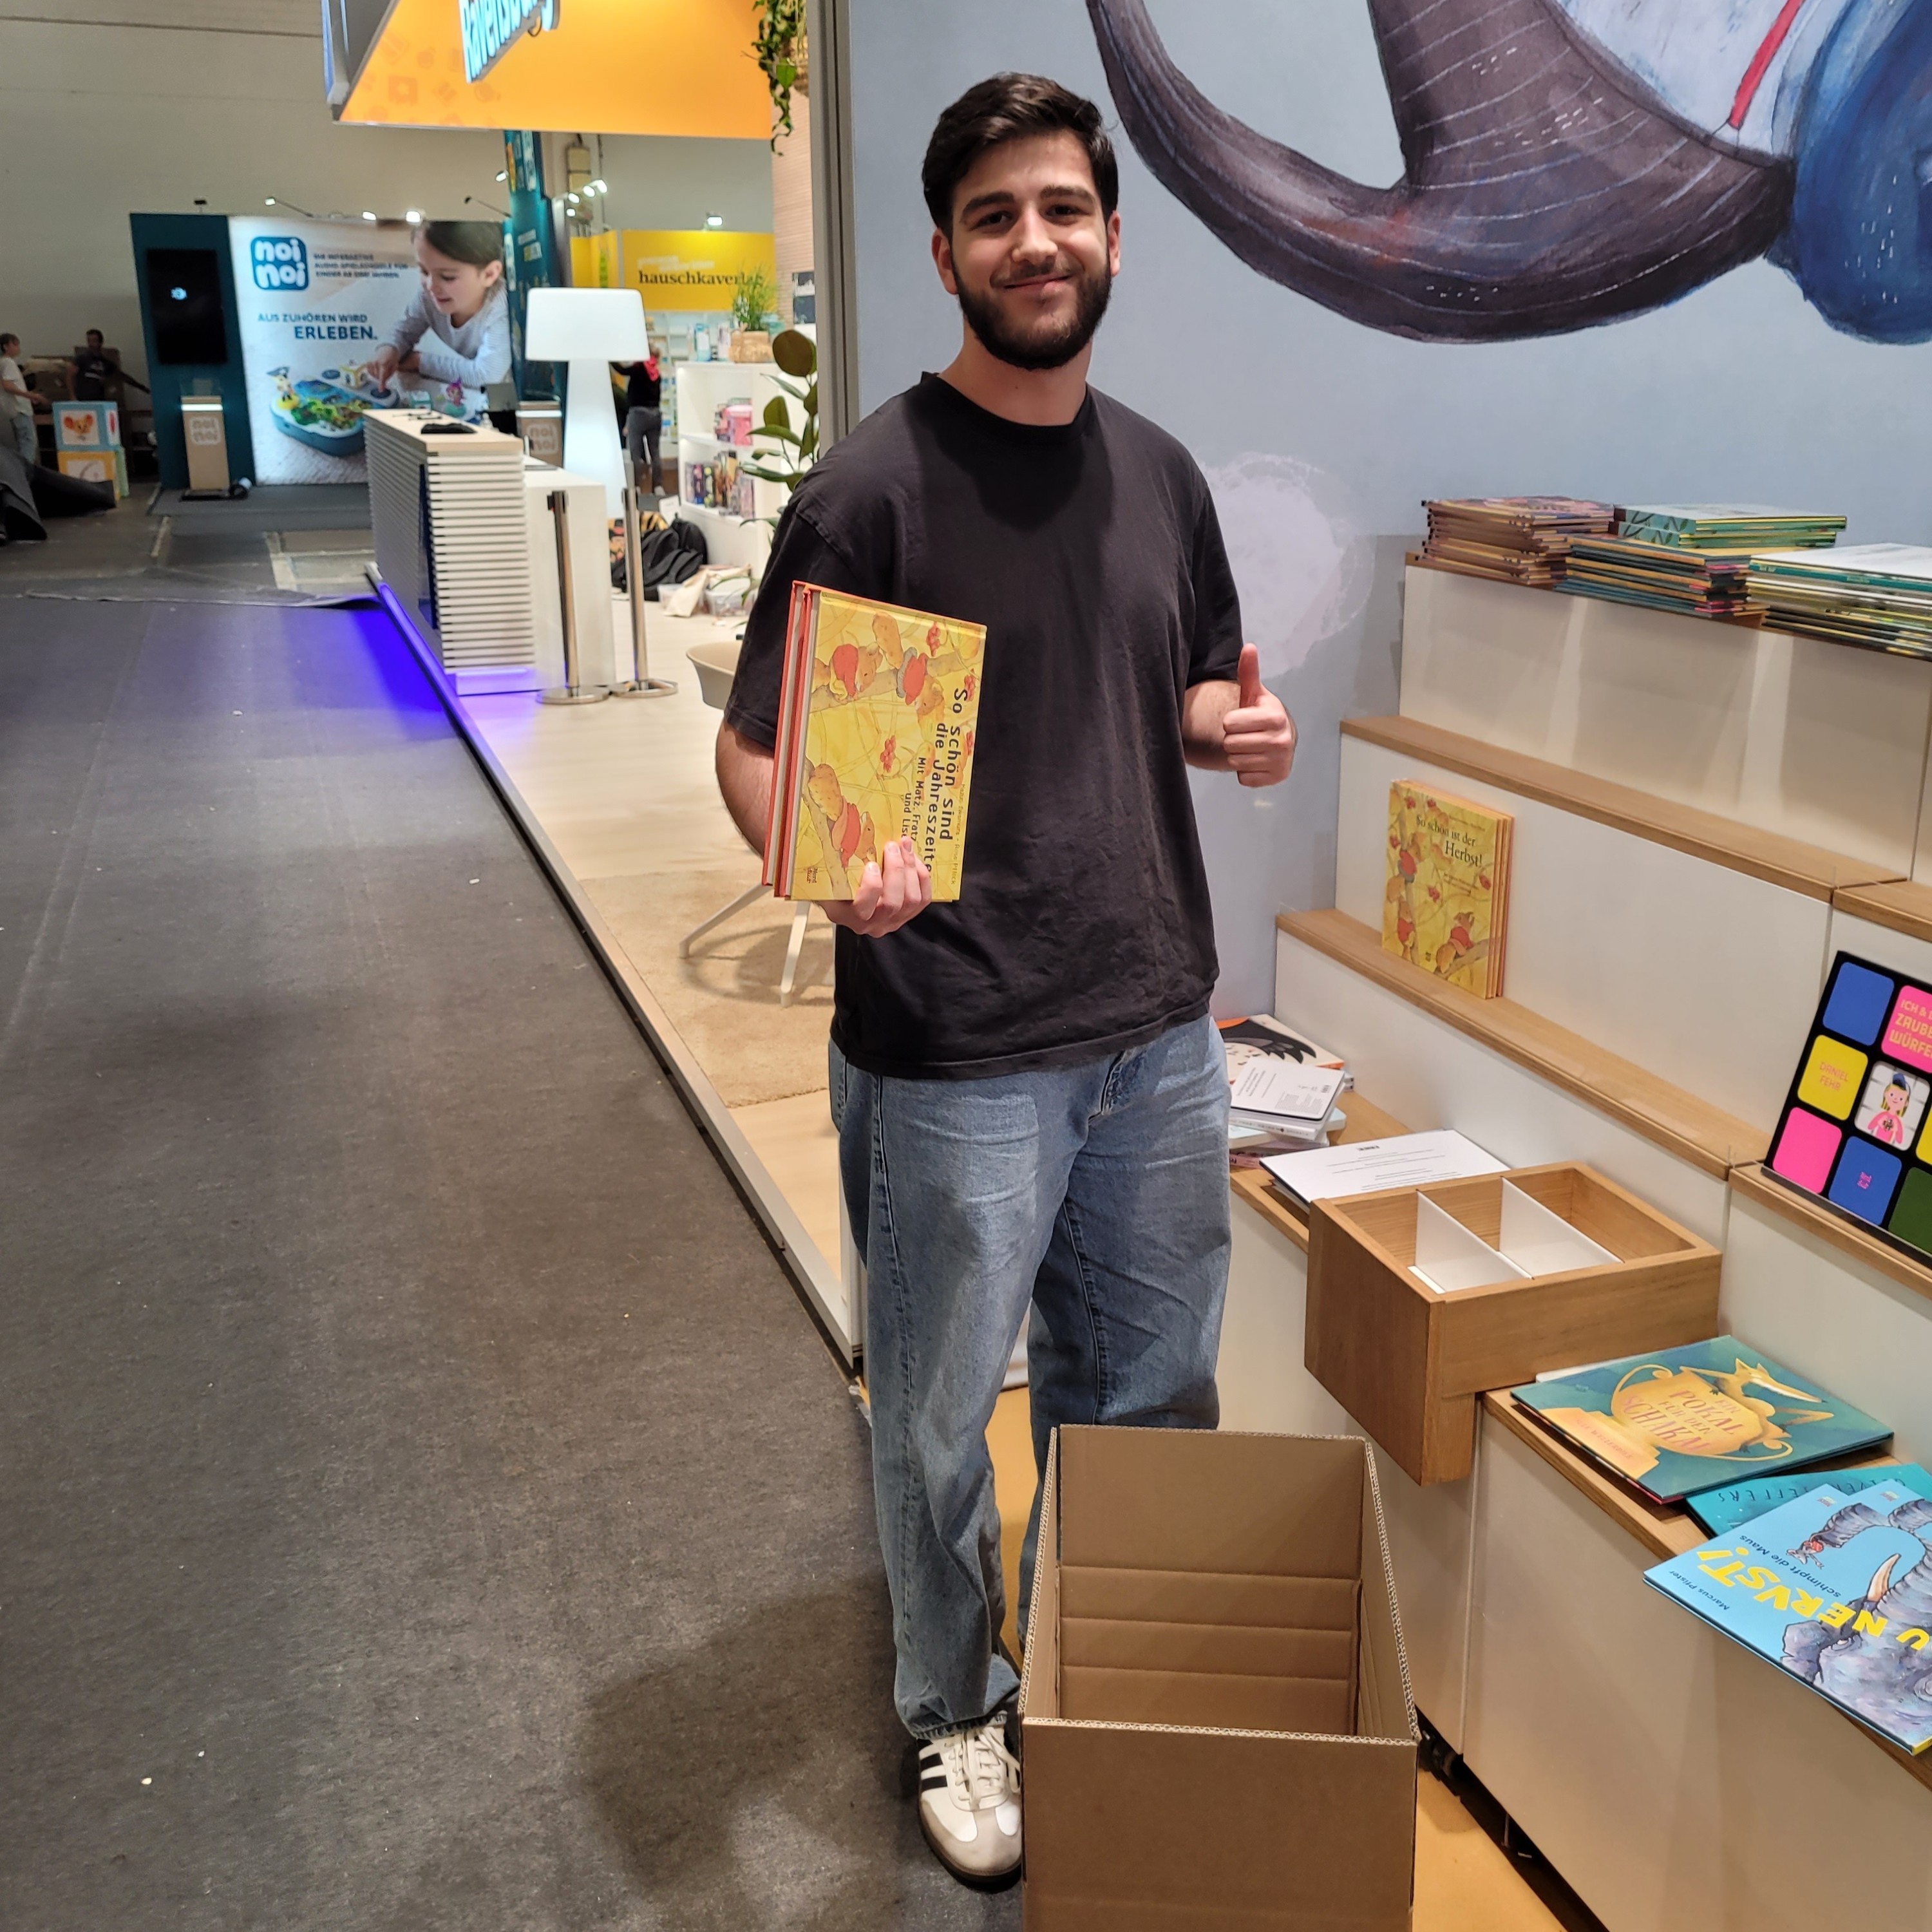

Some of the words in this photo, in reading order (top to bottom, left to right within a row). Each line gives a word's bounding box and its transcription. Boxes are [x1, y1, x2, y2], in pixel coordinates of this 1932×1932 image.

[254, 238, 301, 262] noi
[256, 261, 306, 289] noi
[639, 270, 763, 286] hauschkaverl
[258, 313, 279, 322] AUS
[282, 312, 336, 323] ZUHÖREN
[338, 314, 368, 323] WIRD
[294, 326, 378, 340] ERLEBEN.
[952, 688, 968, 714] So
[935, 723, 949, 748] die
[916, 757, 927, 775] Mit
[945, 726, 961, 786] schön
[904, 793, 912, 813] und
[924, 760, 945, 878] Jahreszeite
[940, 798, 955, 840] sind
[1417, 814, 1426, 827] So
[1452, 830, 1461, 842] ist
[1462, 833, 1476, 847] der
[1445, 840, 1482, 868] Herbst!
[1900, 999, 1919, 1013] ICH
[1919, 1007, 1927, 1017] &
[1889, 1029, 1932, 1059] WÜRFE
[1819, 1061, 1849, 1083] DANIEL
[1820, 1075, 1841, 1092] FEHR
[1658, 1400, 1686, 1418] FÜR
[1683, 1417, 1712, 1435] DEN
[1668, 1390, 1744, 1435] POKAL
[1714, 1399, 1741, 1414] EIN
[1623, 1394, 1712, 1452] SCHAKAL
[1739, 1534, 1770, 1556] Maus
[1771, 1554, 1790, 1567] die
[1669, 1569, 1698, 1591] Pfister
[1696, 1546, 1888, 1638] NERVST!
[1790, 1565, 1842, 1598] schimpft
[1699, 1587, 1730, 1611] Marcus
[1895, 1627, 1932, 1651] U
